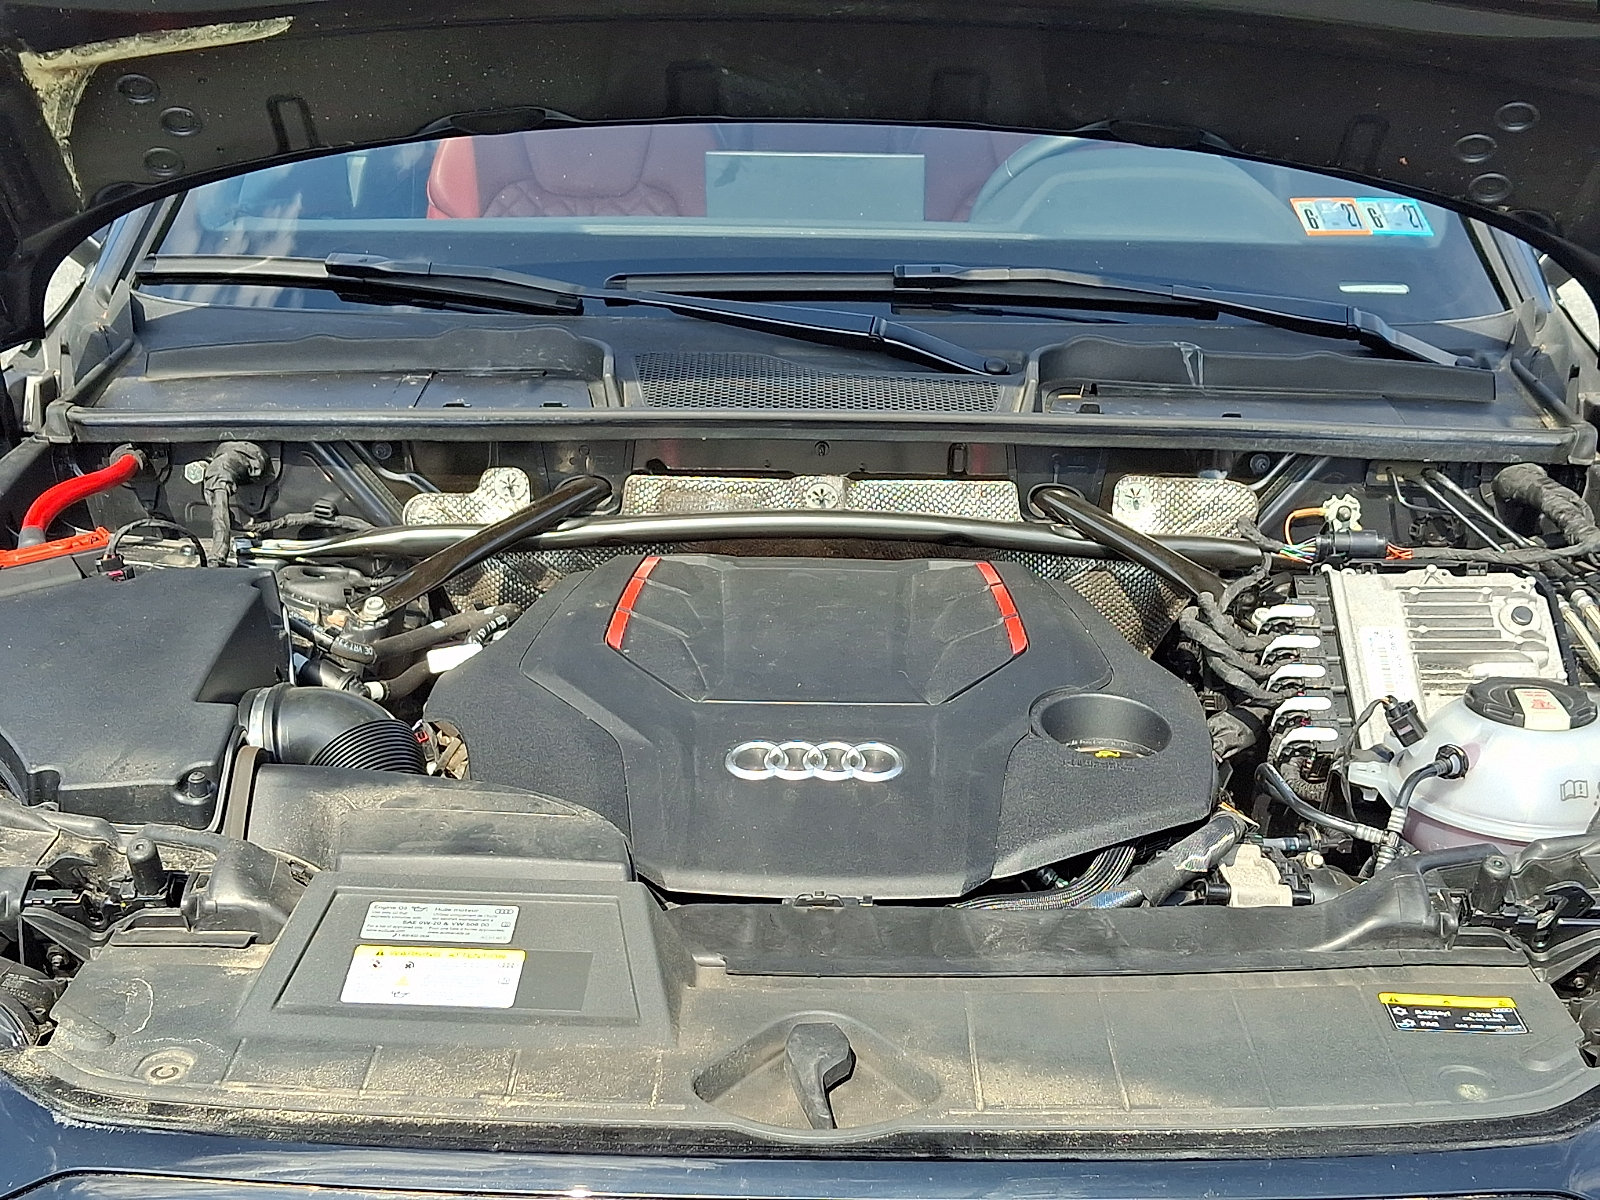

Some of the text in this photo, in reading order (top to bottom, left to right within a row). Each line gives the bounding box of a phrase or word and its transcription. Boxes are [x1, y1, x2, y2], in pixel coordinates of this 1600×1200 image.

[1304, 203, 1362, 229] 6 27
[1367, 204, 1424, 230] 6 27
